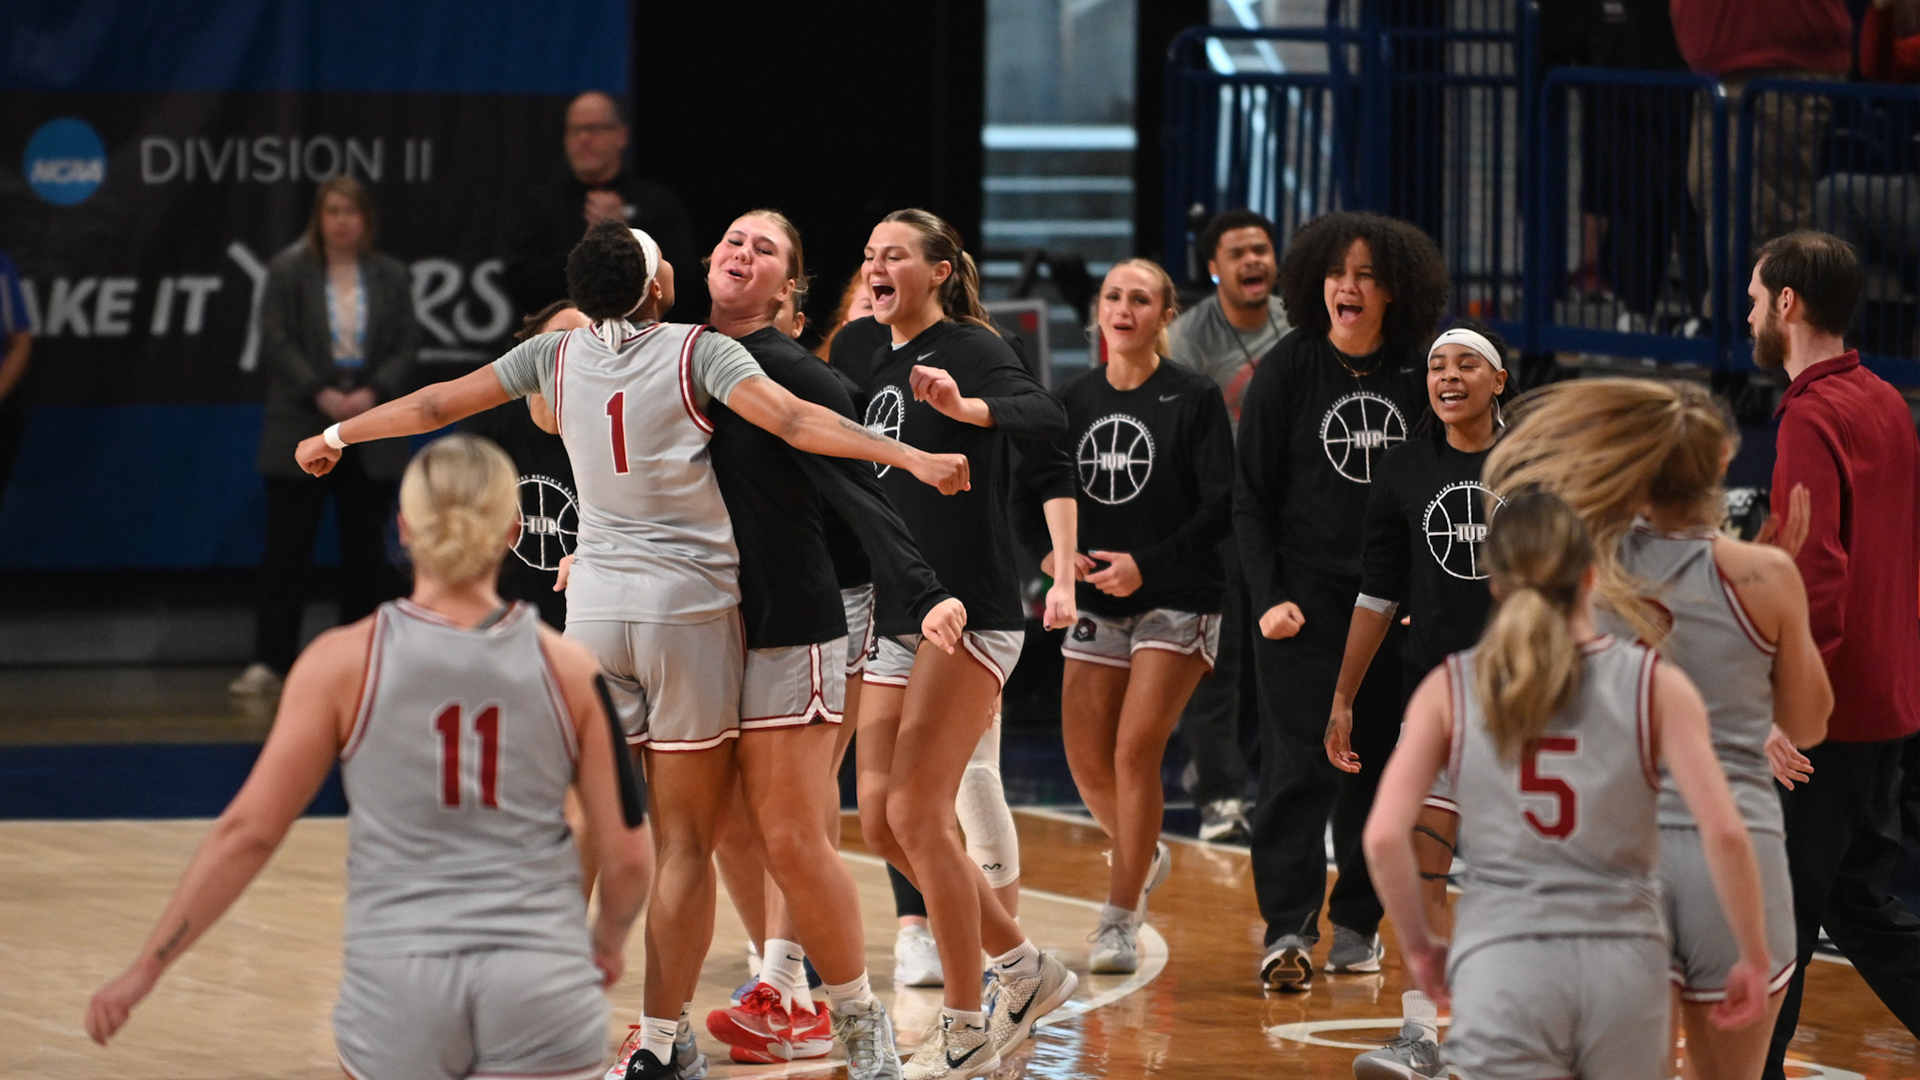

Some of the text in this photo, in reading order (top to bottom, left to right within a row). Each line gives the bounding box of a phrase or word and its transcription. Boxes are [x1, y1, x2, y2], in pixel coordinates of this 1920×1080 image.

[140, 135, 434, 185] DIVISION II
[24, 276, 138, 337] AKE
[150, 275, 222, 337] IT
[604, 390, 631, 476] 1
[1351, 430, 1384, 448] IUP
[1099, 452, 1127, 470] IUP
[525, 515, 557, 536] IUP
[1455, 524, 1488, 542] IUP
[431, 700, 503, 810] 11
[1516, 732, 1582, 844] 5
